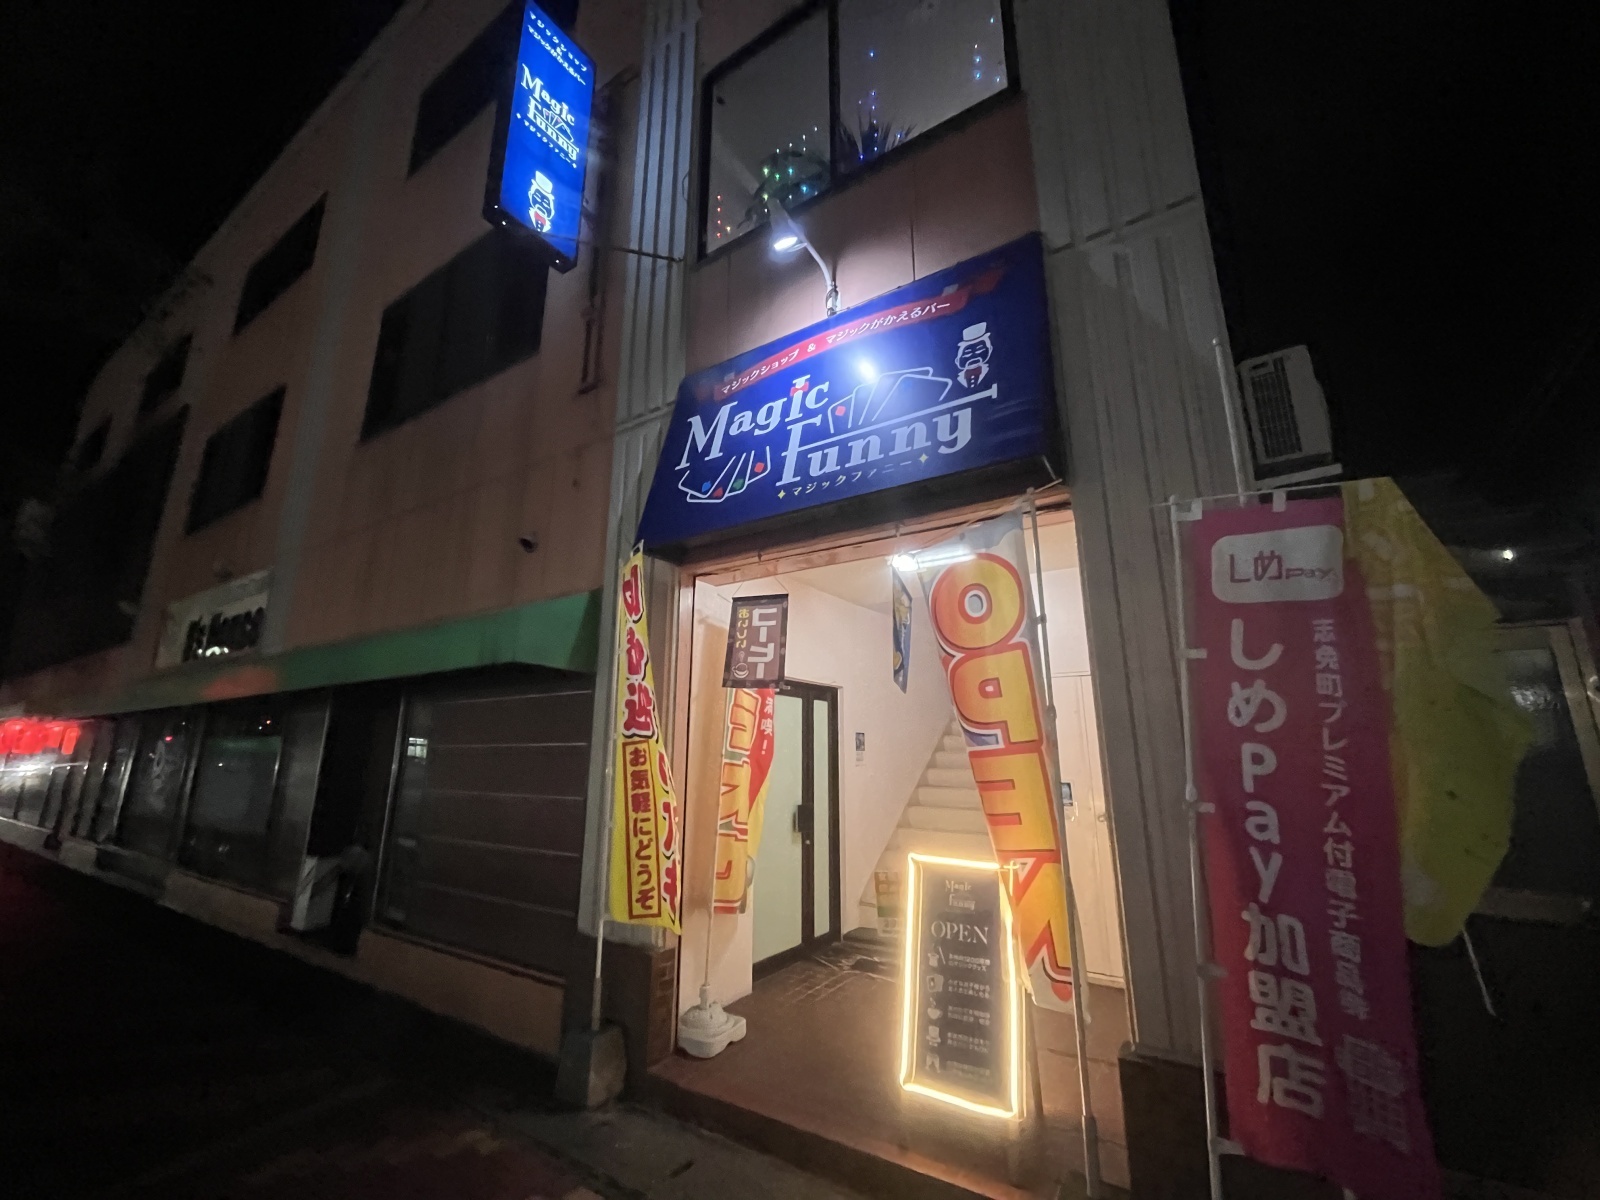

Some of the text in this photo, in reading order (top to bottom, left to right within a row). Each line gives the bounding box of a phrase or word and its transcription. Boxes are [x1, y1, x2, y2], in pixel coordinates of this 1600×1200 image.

[520, 63, 575, 126] Magic
[527, 96, 579, 161] Funny
[721, 302, 950, 394] マジックショップ & マジックがかえるバー
[675, 374, 830, 471] Magic
[775, 384, 998, 488] Funny
[791, 461, 912, 496] マジックファニー
[1227, 618, 1326, 1119] しめPay加盟店
[931, 920, 989, 945] OPEN
